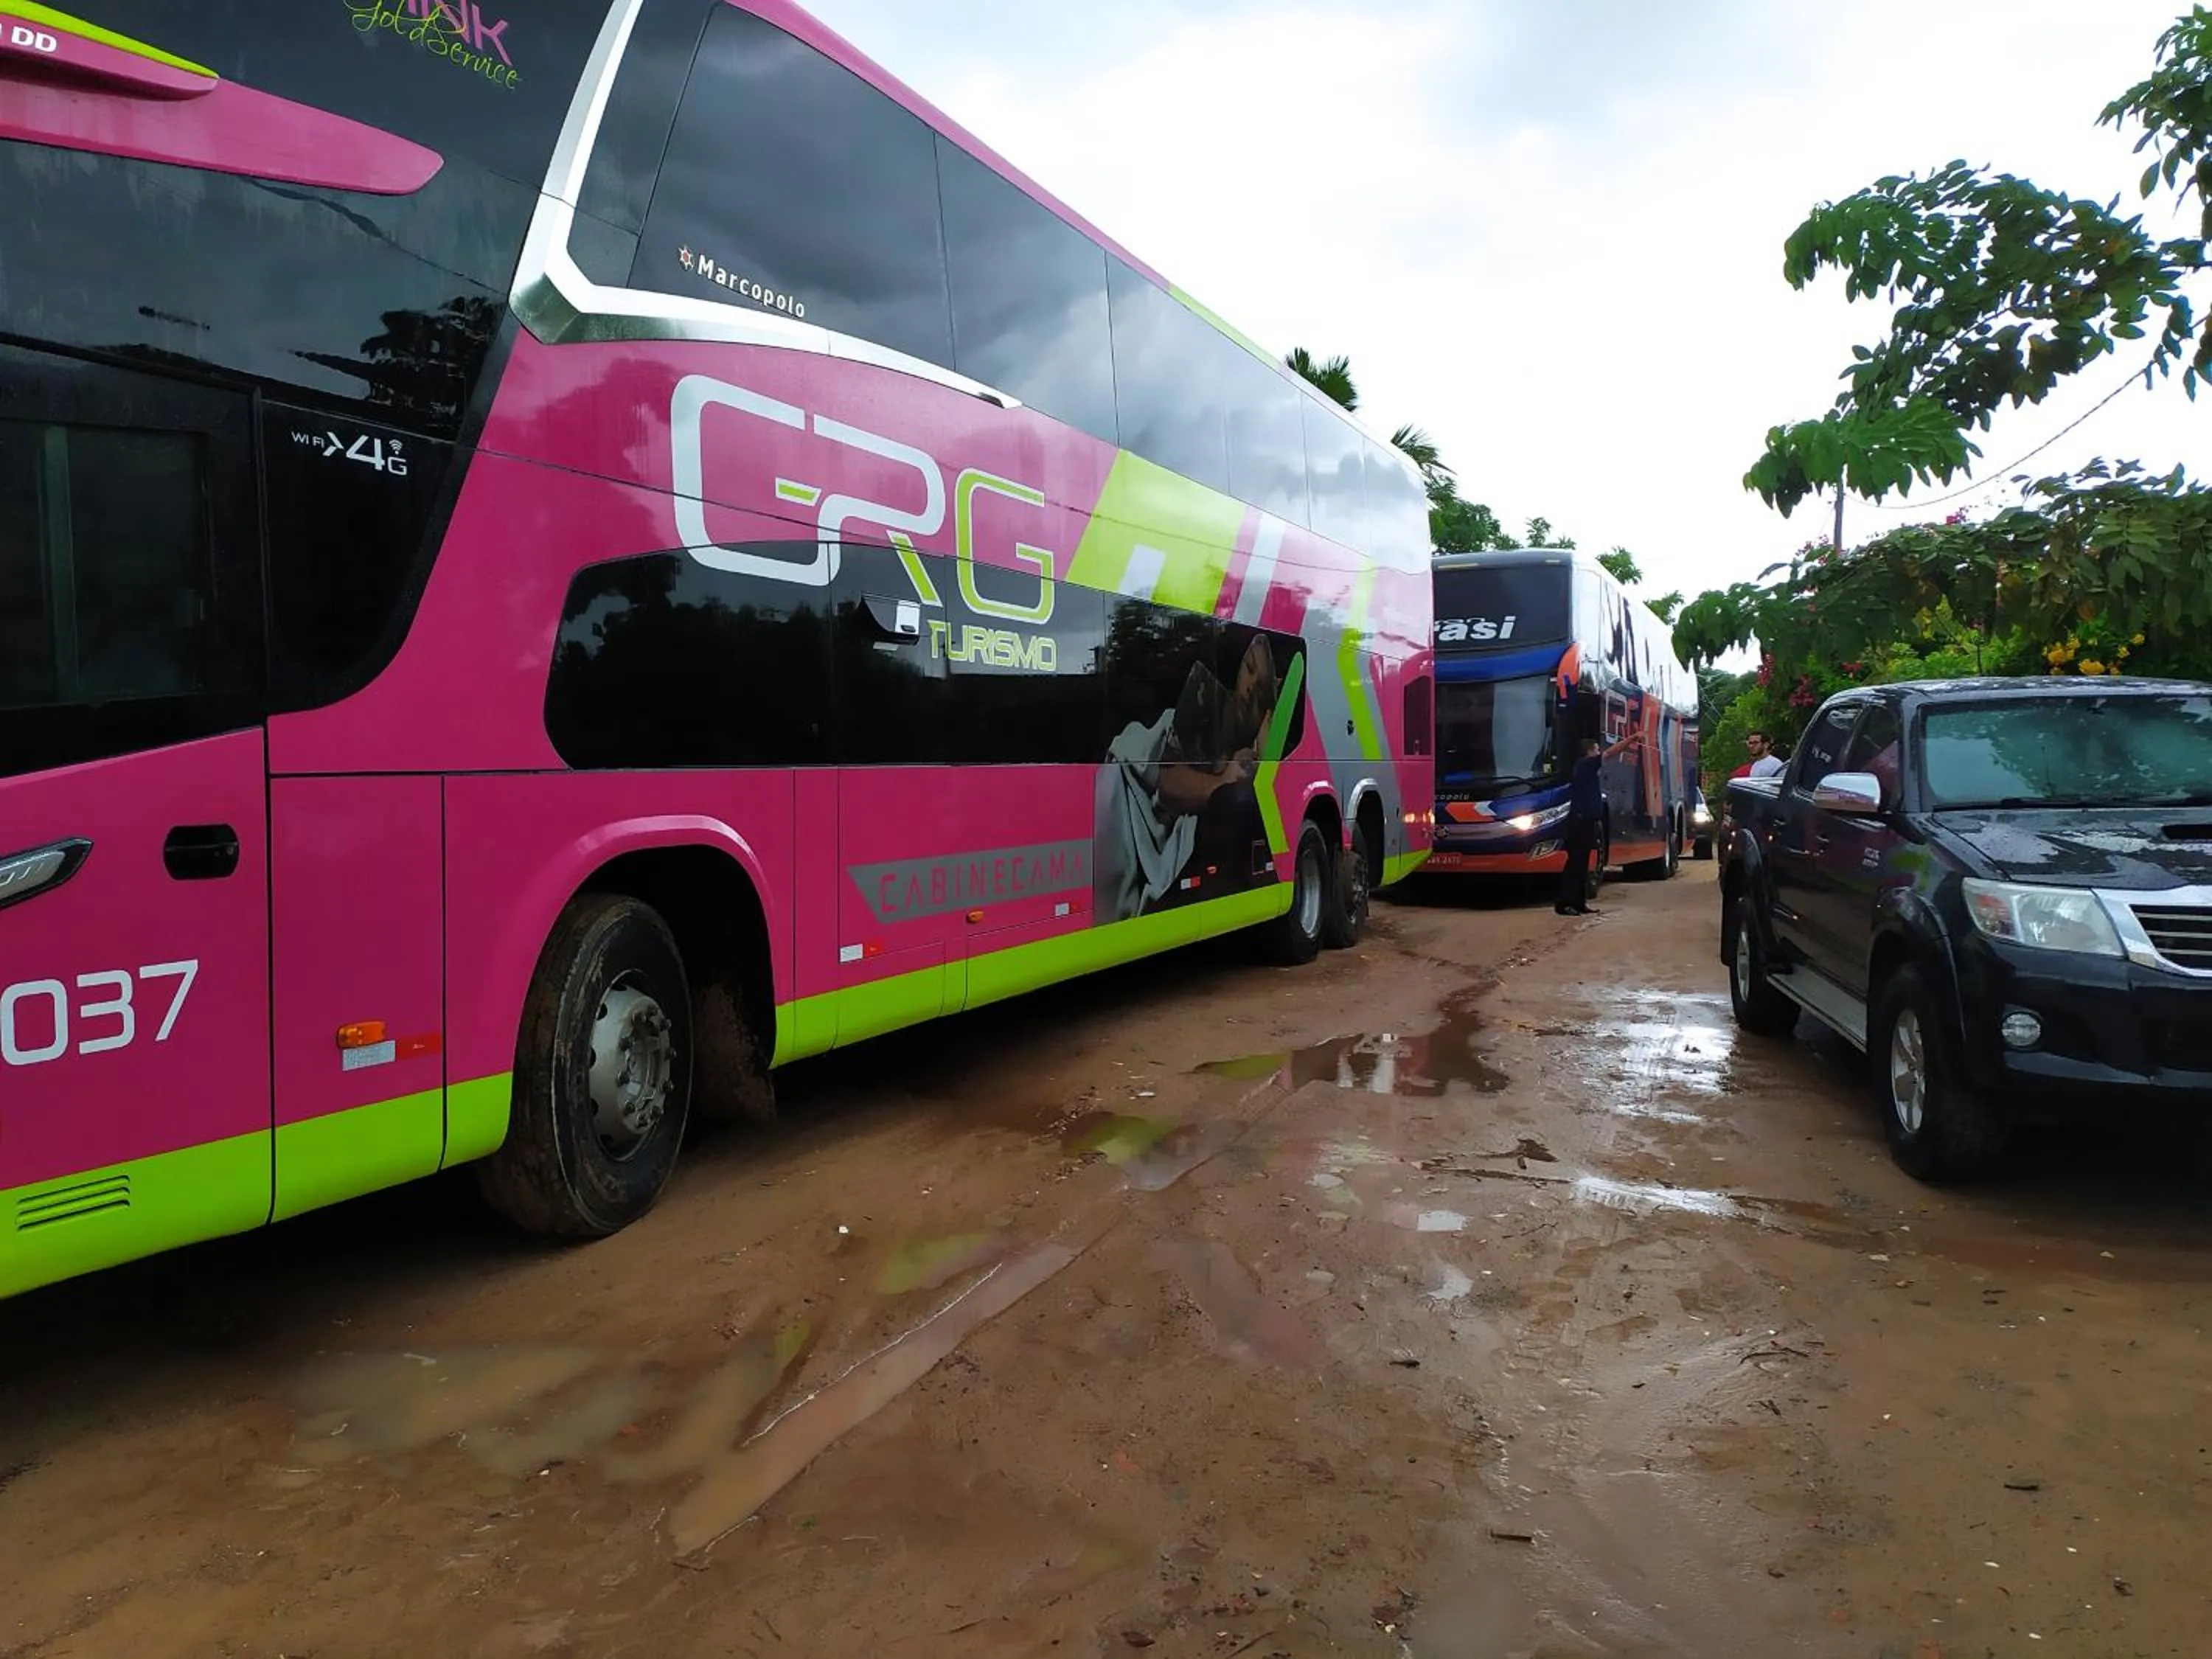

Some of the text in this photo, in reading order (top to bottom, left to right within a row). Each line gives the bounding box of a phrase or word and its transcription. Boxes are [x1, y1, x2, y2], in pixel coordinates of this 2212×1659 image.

[11, 26, 57, 52] DD
[698, 254, 805, 318] Marcopolo
[671, 374, 1054, 624] GRG
[927, 619, 1057, 672] TURISMO
[0, 959, 199, 1066] 037
